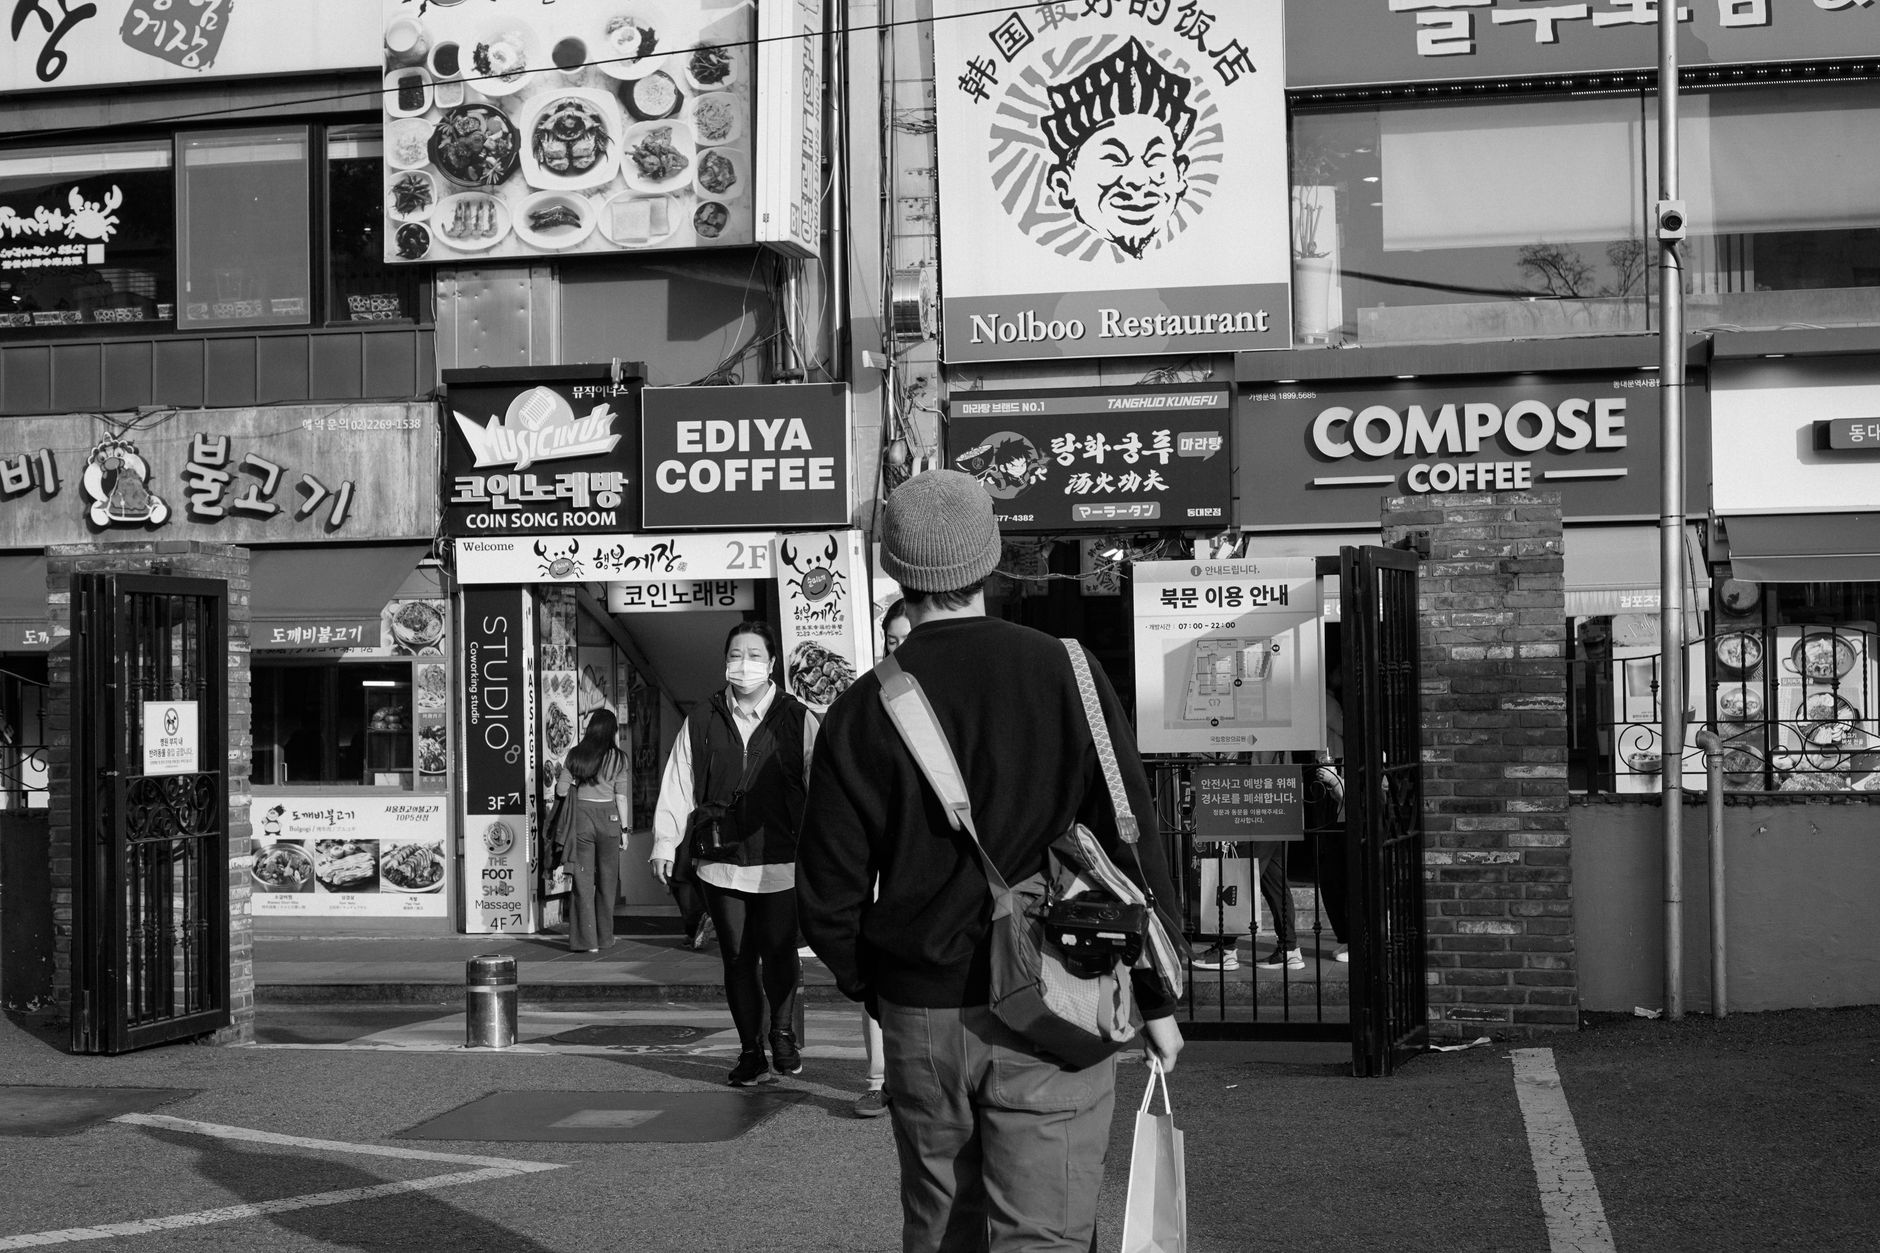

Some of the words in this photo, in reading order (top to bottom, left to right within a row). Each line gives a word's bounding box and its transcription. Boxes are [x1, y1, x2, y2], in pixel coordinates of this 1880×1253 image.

[969, 310, 1086, 345] Nolboo
[1098, 307, 1269, 339] Restaurant
[962, 404, 991, 414] 마라탕
[1021, 402, 1045, 412] NO.1
[1107, 396, 1166, 409] TANGHUO
[1166, 395, 1218, 408] KUNGFU
[676, 417, 813, 453] EDIYA
[1312, 397, 1628, 459] COMPOSE
[1180, 436, 1222, 451] 마라탕
[185, 432, 353, 526] 불고기
[654, 456, 836, 494] COFFEE
[1064, 469, 1170, 495] 汤火功夫
[1406, 460, 1533, 493] COFFEE
[450, 471, 629, 509] 코인노래방
[465, 514, 507, 529] COIN
[511, 513, 558, 528] SONG
[562, 511, 617, 527] ROOM
[1078, 504, 1154, 518] マーラータン
[1187, 508, 1222, 517] 동대문점
[462, 540, 515, 553] Welcome
[592, 538, 682, 573] 행복게장
[725, 540, 768, 570] 2F
[1204, 565, 1260, 576] 안내드립니다.
[623, 580, 738, 608] 코인노래방
[1160, 588, 1199, 609] 북문
[1205, 586, 1244, 608] 이용
[1250, 584, 1289, 607] 안내
[794, 599, 841, 623] 행복게장
[270, 625, 363, 644] 도깨비불고기
[469, 641, 479, 693] Coworking
[483, 616, 509, 749] STUDIO
[471, 695, 480, 725] studio
[527, 657, 535, 770] MASSAGE
[1201, 778, 1241, 790] 안전사고
[1243, 777, 1273, 789] 예방을
[1276, 777, 1297, 788] 위해
[487, 796, 505, 811] 3F
[1201, 793, 1241, 804] 경사로를
[1243, 792, 1297, 804] 폐쇄합니다.
[292, 808, 355, 826] 도깨비불고기
[488, 856, 508, 867] THE
[481, 868, 514, 880] FOOT
[475, 900, 522, 912] Massage
[490, 917, 507, 931] 4F
